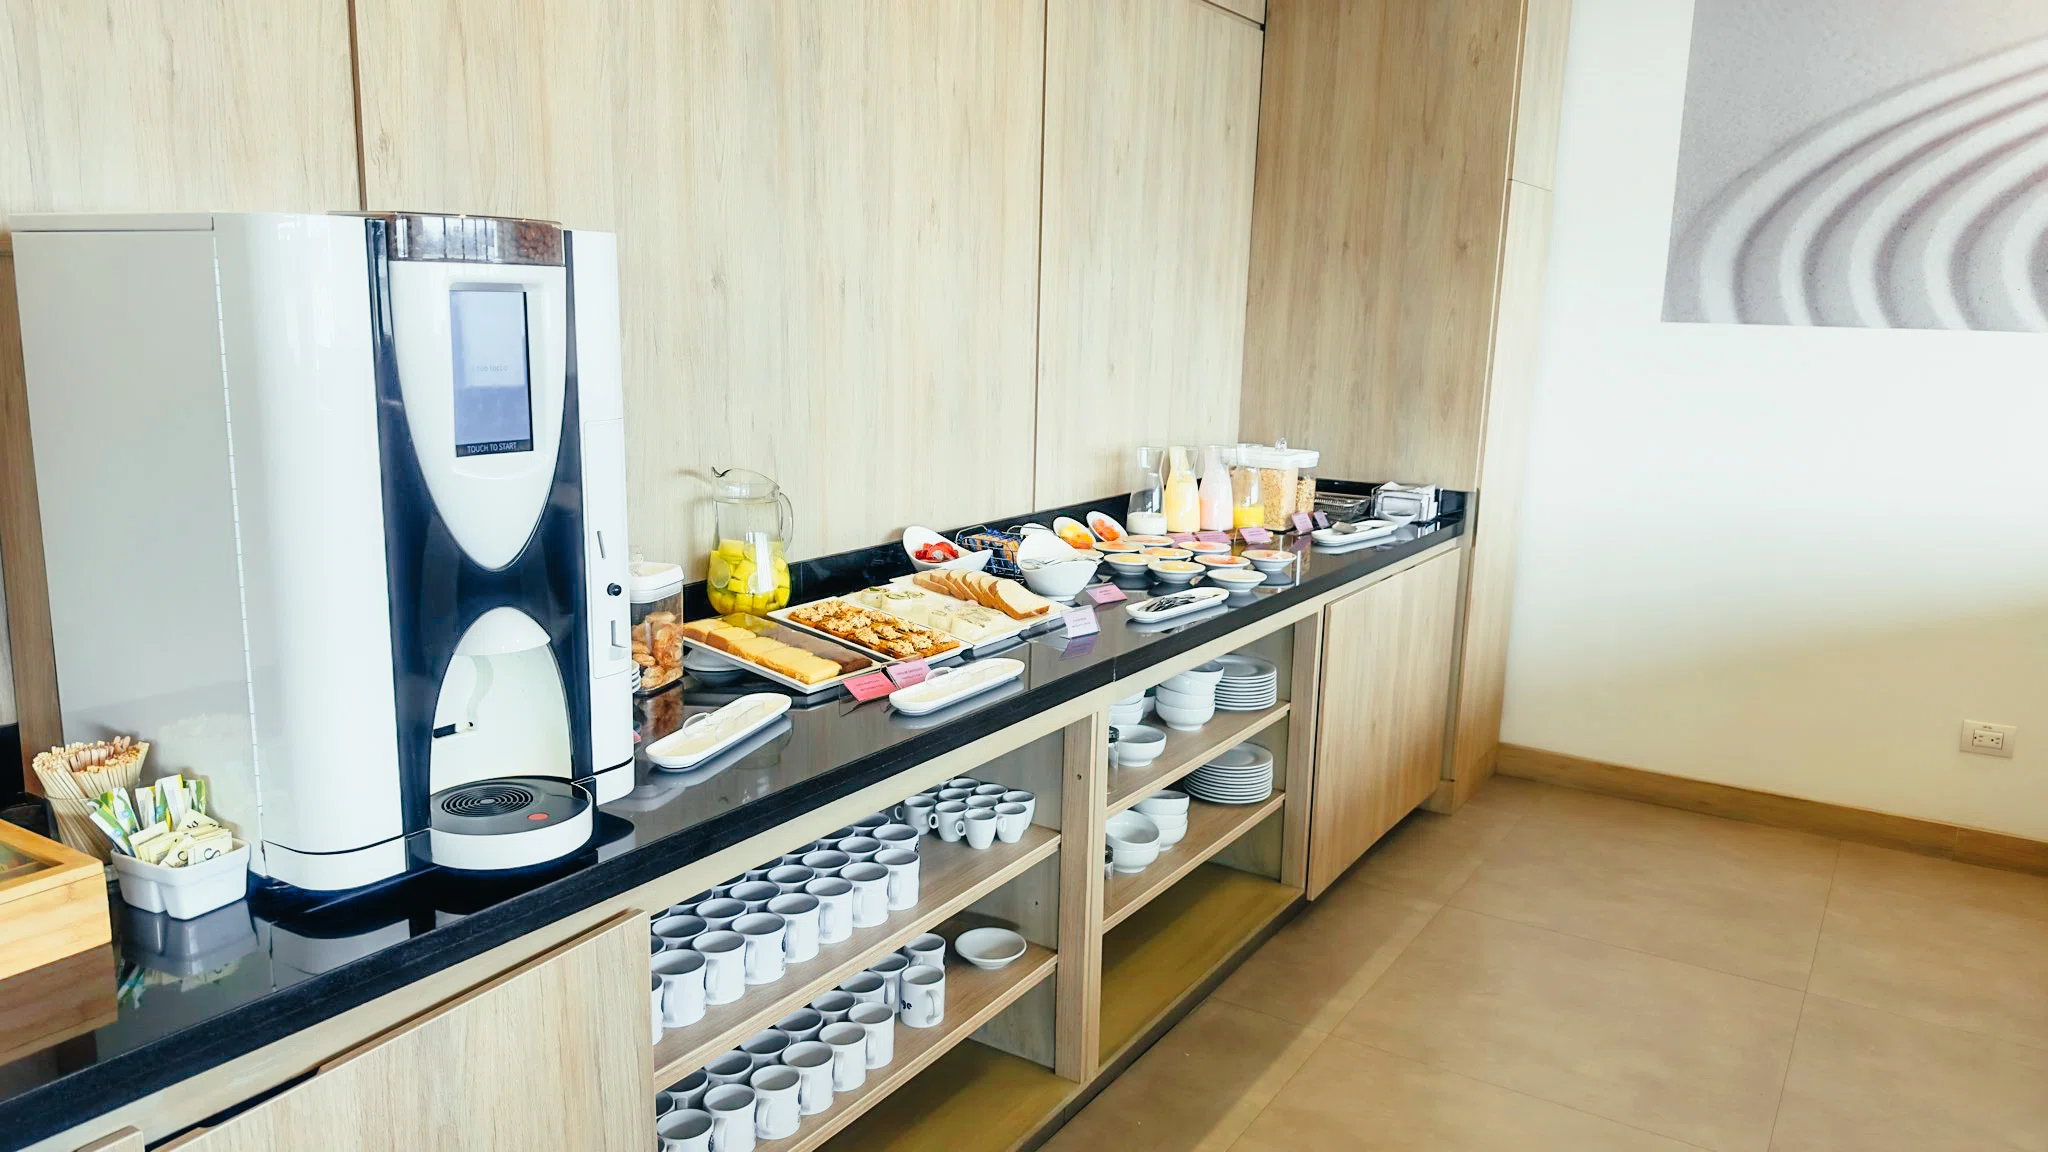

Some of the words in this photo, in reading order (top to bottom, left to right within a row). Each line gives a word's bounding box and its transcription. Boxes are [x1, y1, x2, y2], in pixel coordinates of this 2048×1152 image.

[467, 444, 489, 453] TOUCH
[490, 443, 498, 451] TO
[499, 442, 517, 450] START
